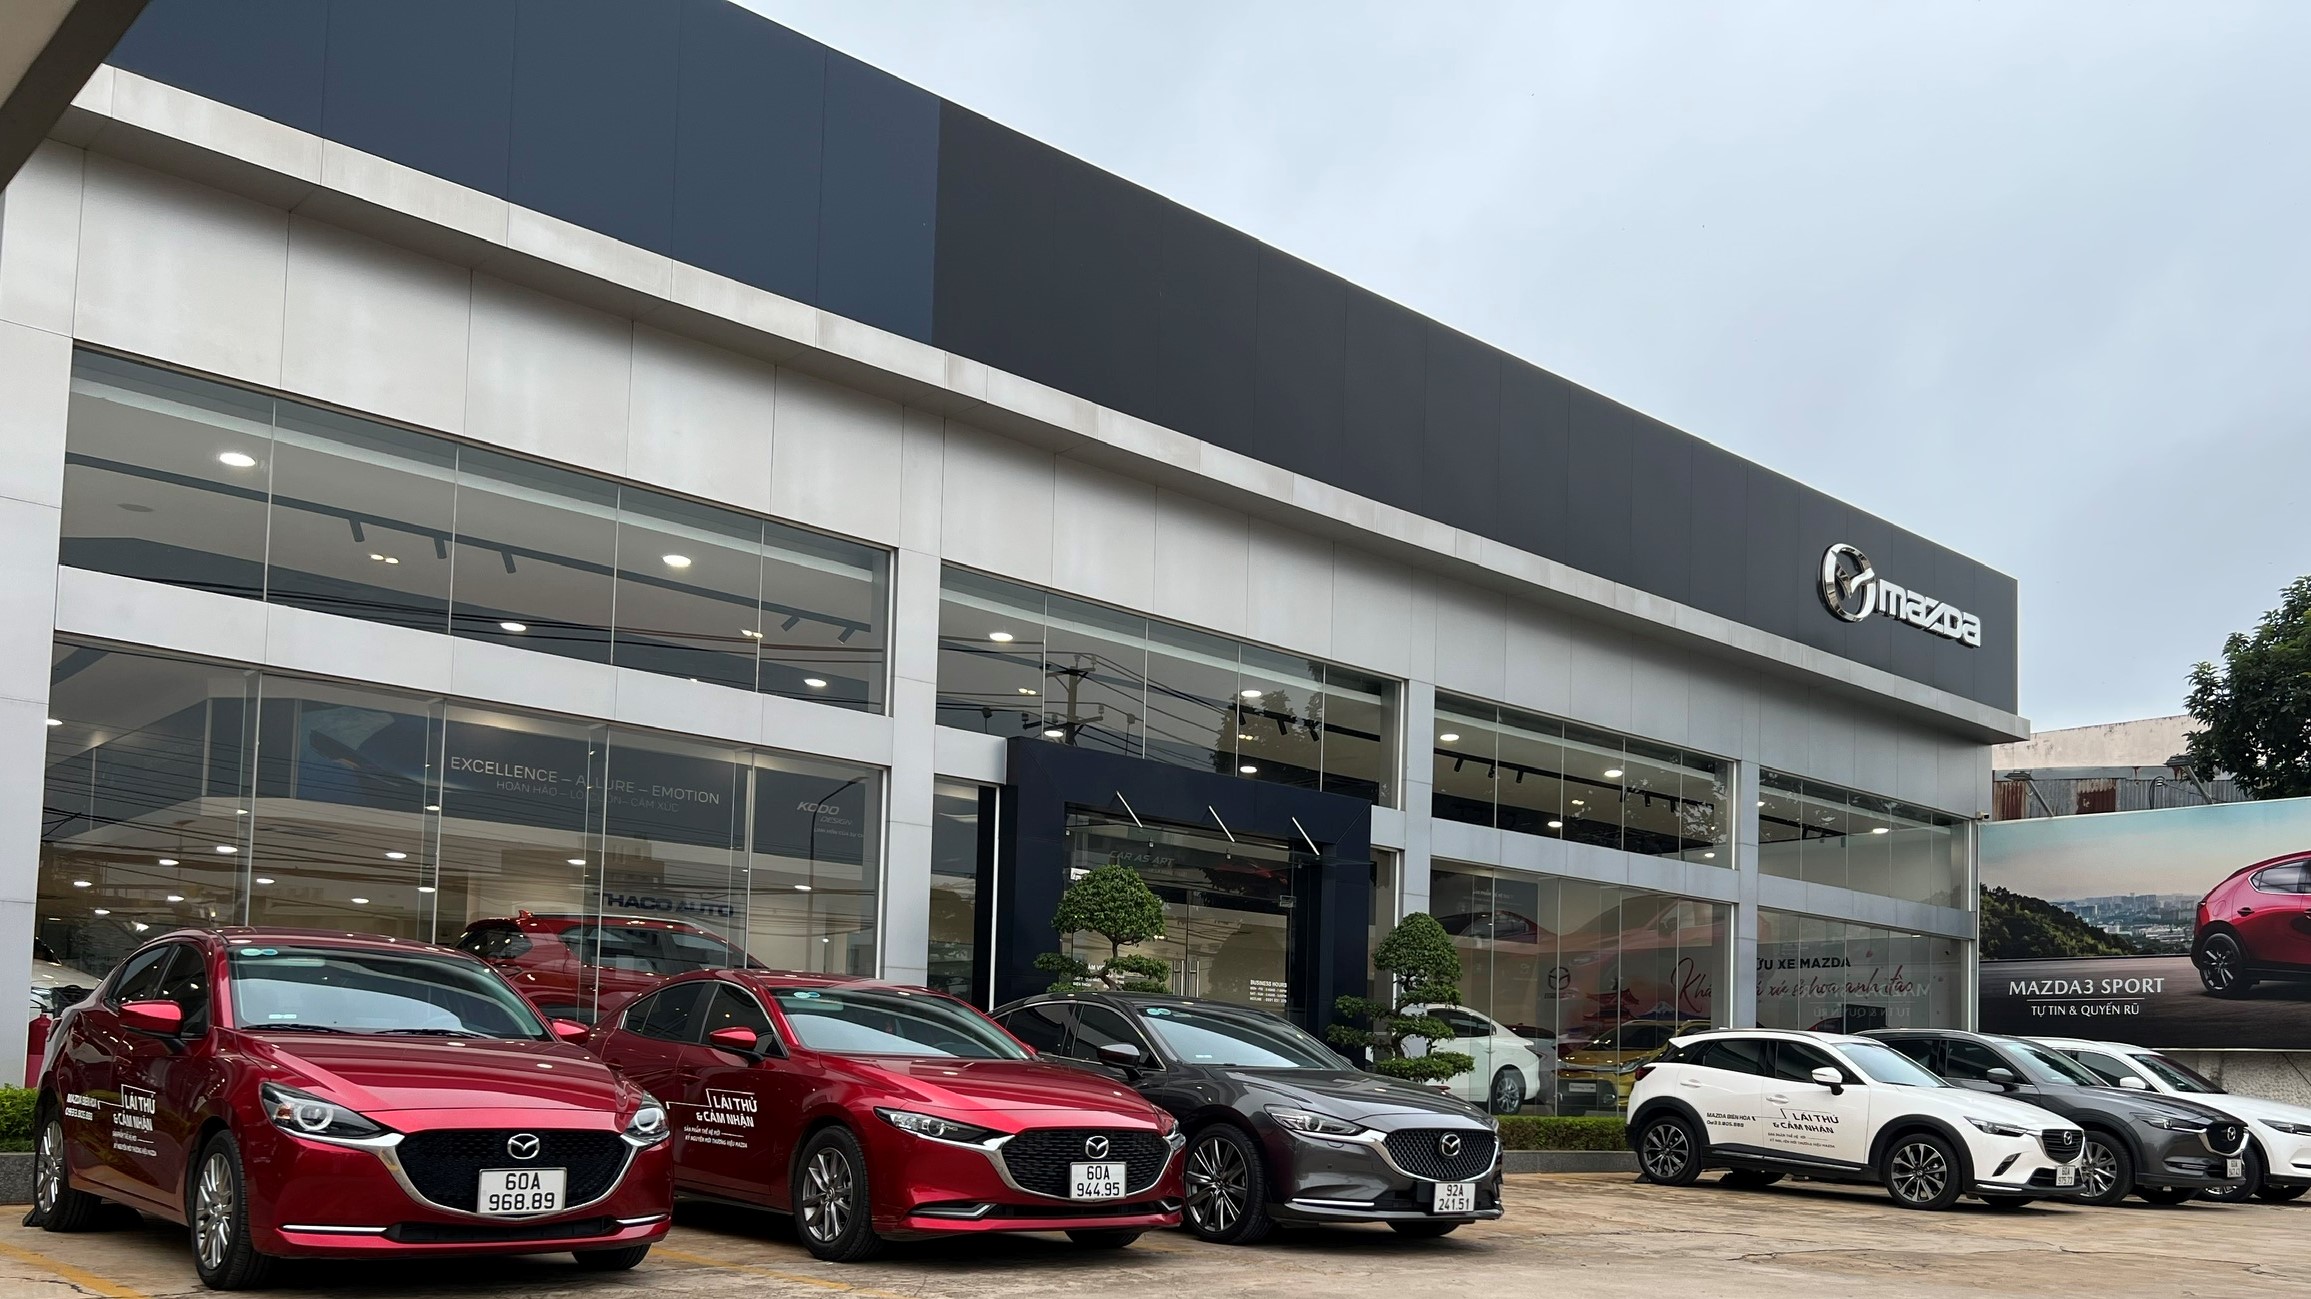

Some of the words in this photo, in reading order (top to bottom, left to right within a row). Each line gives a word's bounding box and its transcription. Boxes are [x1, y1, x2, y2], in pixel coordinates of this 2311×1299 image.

[1879, 578, 1981, 647] mazda
[451, 756, 558, 783] EXCELLENCE
[576, 774, 635, 794] ALURE
[652, 785, 720, 805] EMOTION
[797, 801, 840, 815] KODO
[1134, 854, 1150, 863] AS
[593, 892, 673, 912] THACO
[1777, 958, 1796, 970] XE
[1800, 957, 1851, 969] MAZDA
[2008, 979, 2094, 996] MAZDA3
[2100, 978, 2165, 994] SPORT
[2048, 1005, 2066, 1016] TIN
[2069, 1006, 2078, 1016] &
[2080, 1001, 2121, 1017] QUYẾN
[2124, 1002, 2140, 1015] RŨ
[124, 1091, 138, 1111] LÁI
[713, 1093, 733, 1110] LÁI
[733, 1096, 758, 1113] THỬ
[696, 1111, 703, 1121] &
[703, 1108, 726, 1124] CẢM
[726, 1113, 755, 1128] NHẬN
[1780, 1119, 1804, 1131] CẢM
[1792, 1110, 1813, 1122] LÁI
[1813, 1112, 1840, 1124] THỬ
[1087, 1165, 1110, 1181] 60A
[505, 1172, 541, 1191] 60A
[1077, 1182, 1120, 1197] 944.95
[1446, 1184, 1464, 1197] 92A
[489, 1192, 555, 1211] 968.89
[1438, 1198, 1470, 1211] 241.51
